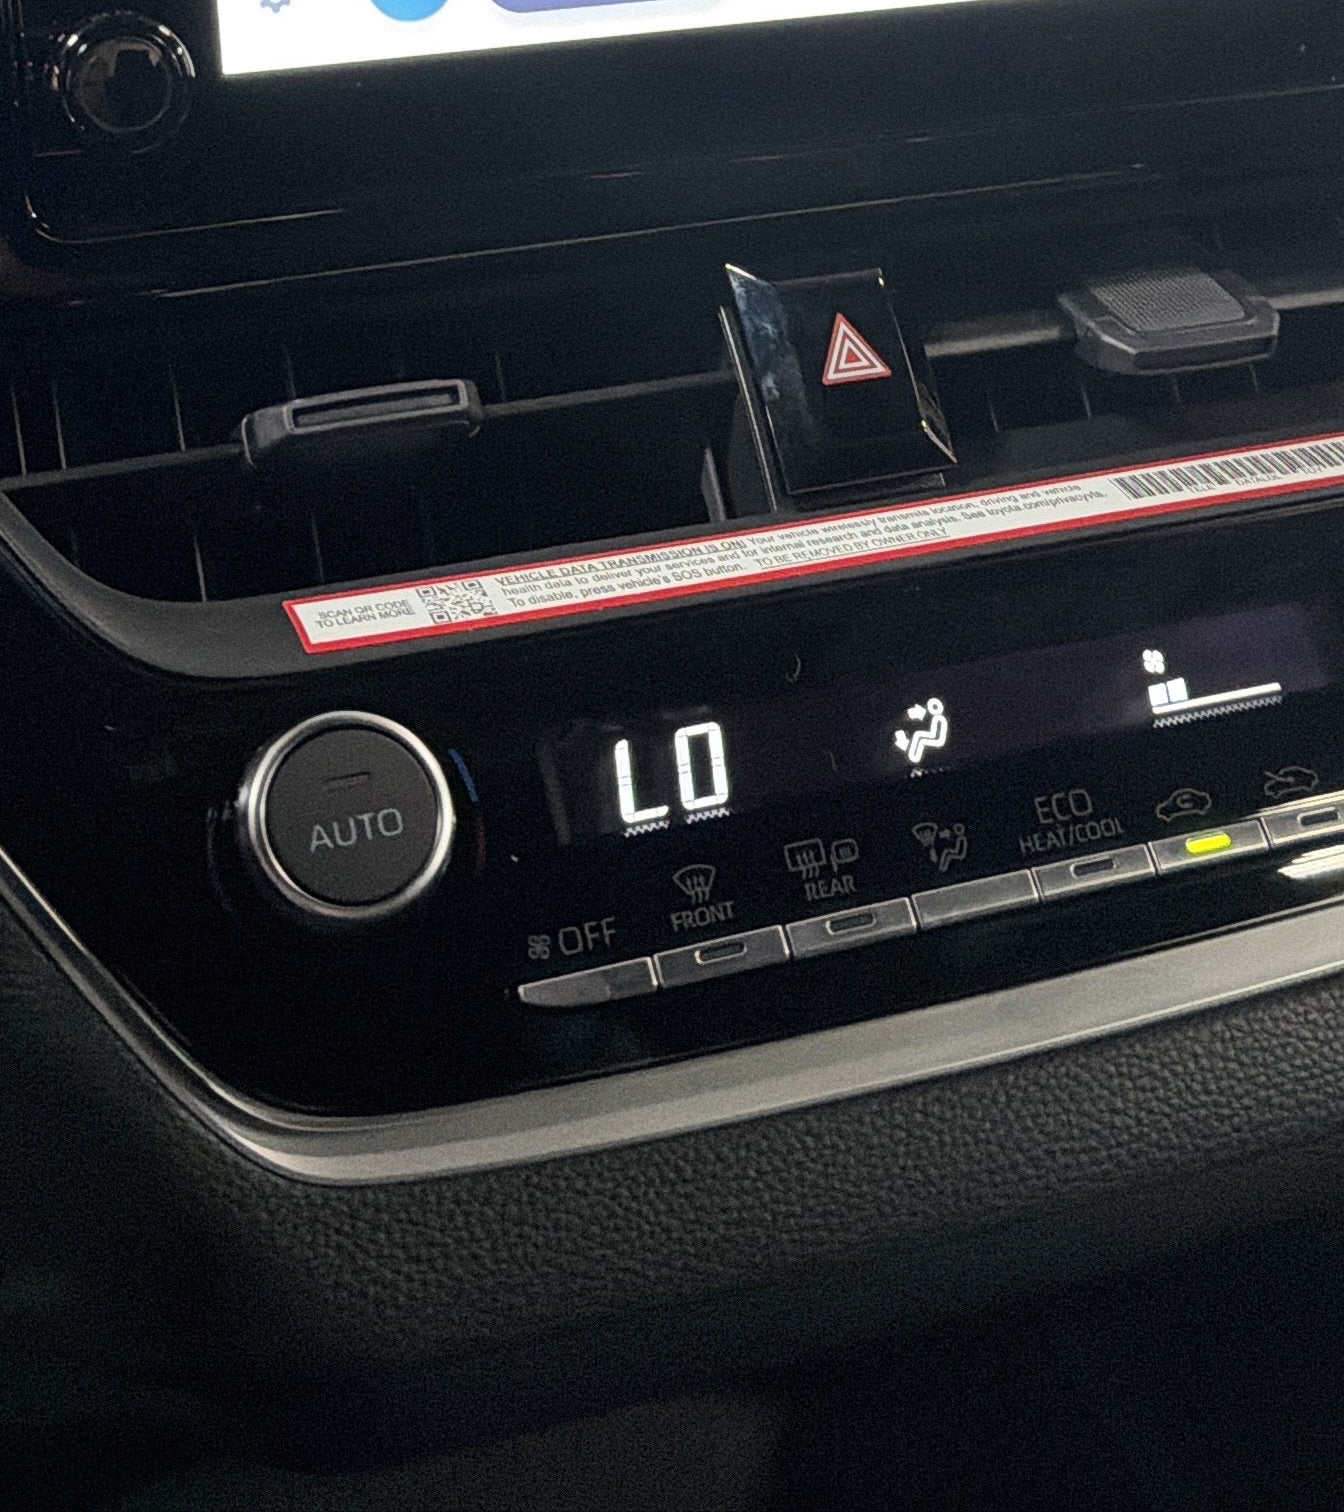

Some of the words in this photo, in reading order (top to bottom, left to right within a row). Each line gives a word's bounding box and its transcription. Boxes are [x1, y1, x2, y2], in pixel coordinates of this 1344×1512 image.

[495, 569, 558, 587] VEHICLE
[559, 562, 598, 577] DATA
[597, 544, 705, 571] TRANSMISSION
[747, 535, 775, 546] Your
[777, 528, 820, 540] vehicle
[821, 519, 877, 534] wirelessly
[877, 508, 930, 523] transmits
[980, 494, 1019, 507] driving
[1019, 491, 1042, 500] and
[1042, 485, 1082, 496] vehicle
[500, 584, 543, 597] health
[544, 578, 573, 590] data
[575, 576, 589, 585] to
[592, 569, 633, 583] deliver
[635, 565, 662, 578] your
[664, 557, 716, 571] services
[717, 551, 740, 562] and
[741, 548, 759, 558] for
[760, 541, 806, 555] internal
[806, 531, 859, 547] research
[860, 527, 883, 538] and
[883, 522, 909, 534] data
[961, 509, 986, 520] See
[507, 598, 526, 608] To
[528, 591, 579, 605] disable,
[579, 584, 617, 599] press
[617, 575, 671, 591] vehicle's
[671, 568, 703, 582] SOS
[704, 561, 747, 576] button.
[753, 556, 774, 567] TO
[775, 553, 792, 564] BE
[792, 544, 854, 561] REMOVED
[853, 539, 870, 550] BY
[871, 532, 916, 547] OWNER
[917, 527, 948, 539] ONLY
[316, 619, 335, 629] TO
[336, 613, 377, 627] LEARN
[378, 608, 417, 620] MORE
[317, 607, 354, 619] SCAN
[375, 599, 411, 611] CODE
[614, 721, 729, 823] LO
[1034, 789, 1094, 824] ECO
[309, 807, 405, 855] AUTO
[1018, 817, 1125, 856] HEAT/COOL
[804, 874, 857, 902] REAR
[670, 900, 736, 933] FRONT
[558, 917, 616, 956] OFF
